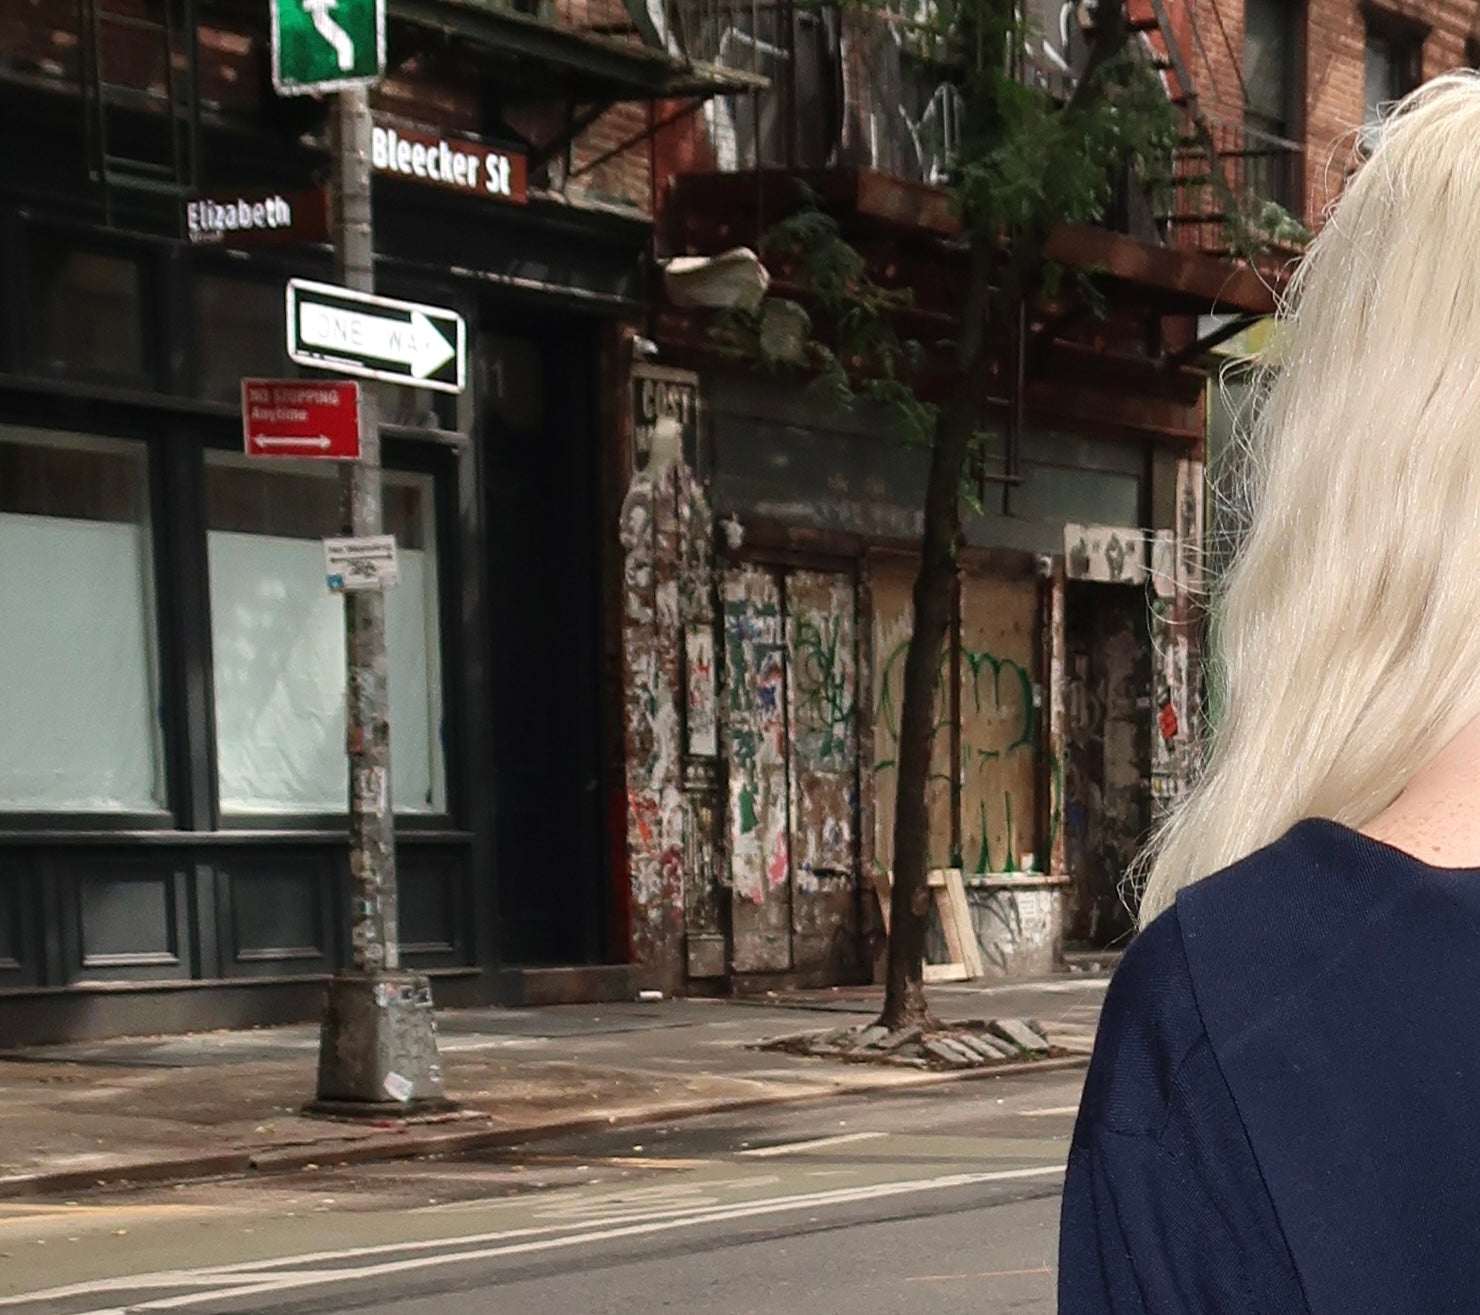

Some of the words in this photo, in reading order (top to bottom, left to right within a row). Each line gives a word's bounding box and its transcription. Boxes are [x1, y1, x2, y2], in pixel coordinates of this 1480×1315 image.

[372, 126, 480, 188] Bleecker
[485, 152, 511, 196] St
[187, 195, 292, 231] Elizabeth
[317, 312, 363, 348] ONE
